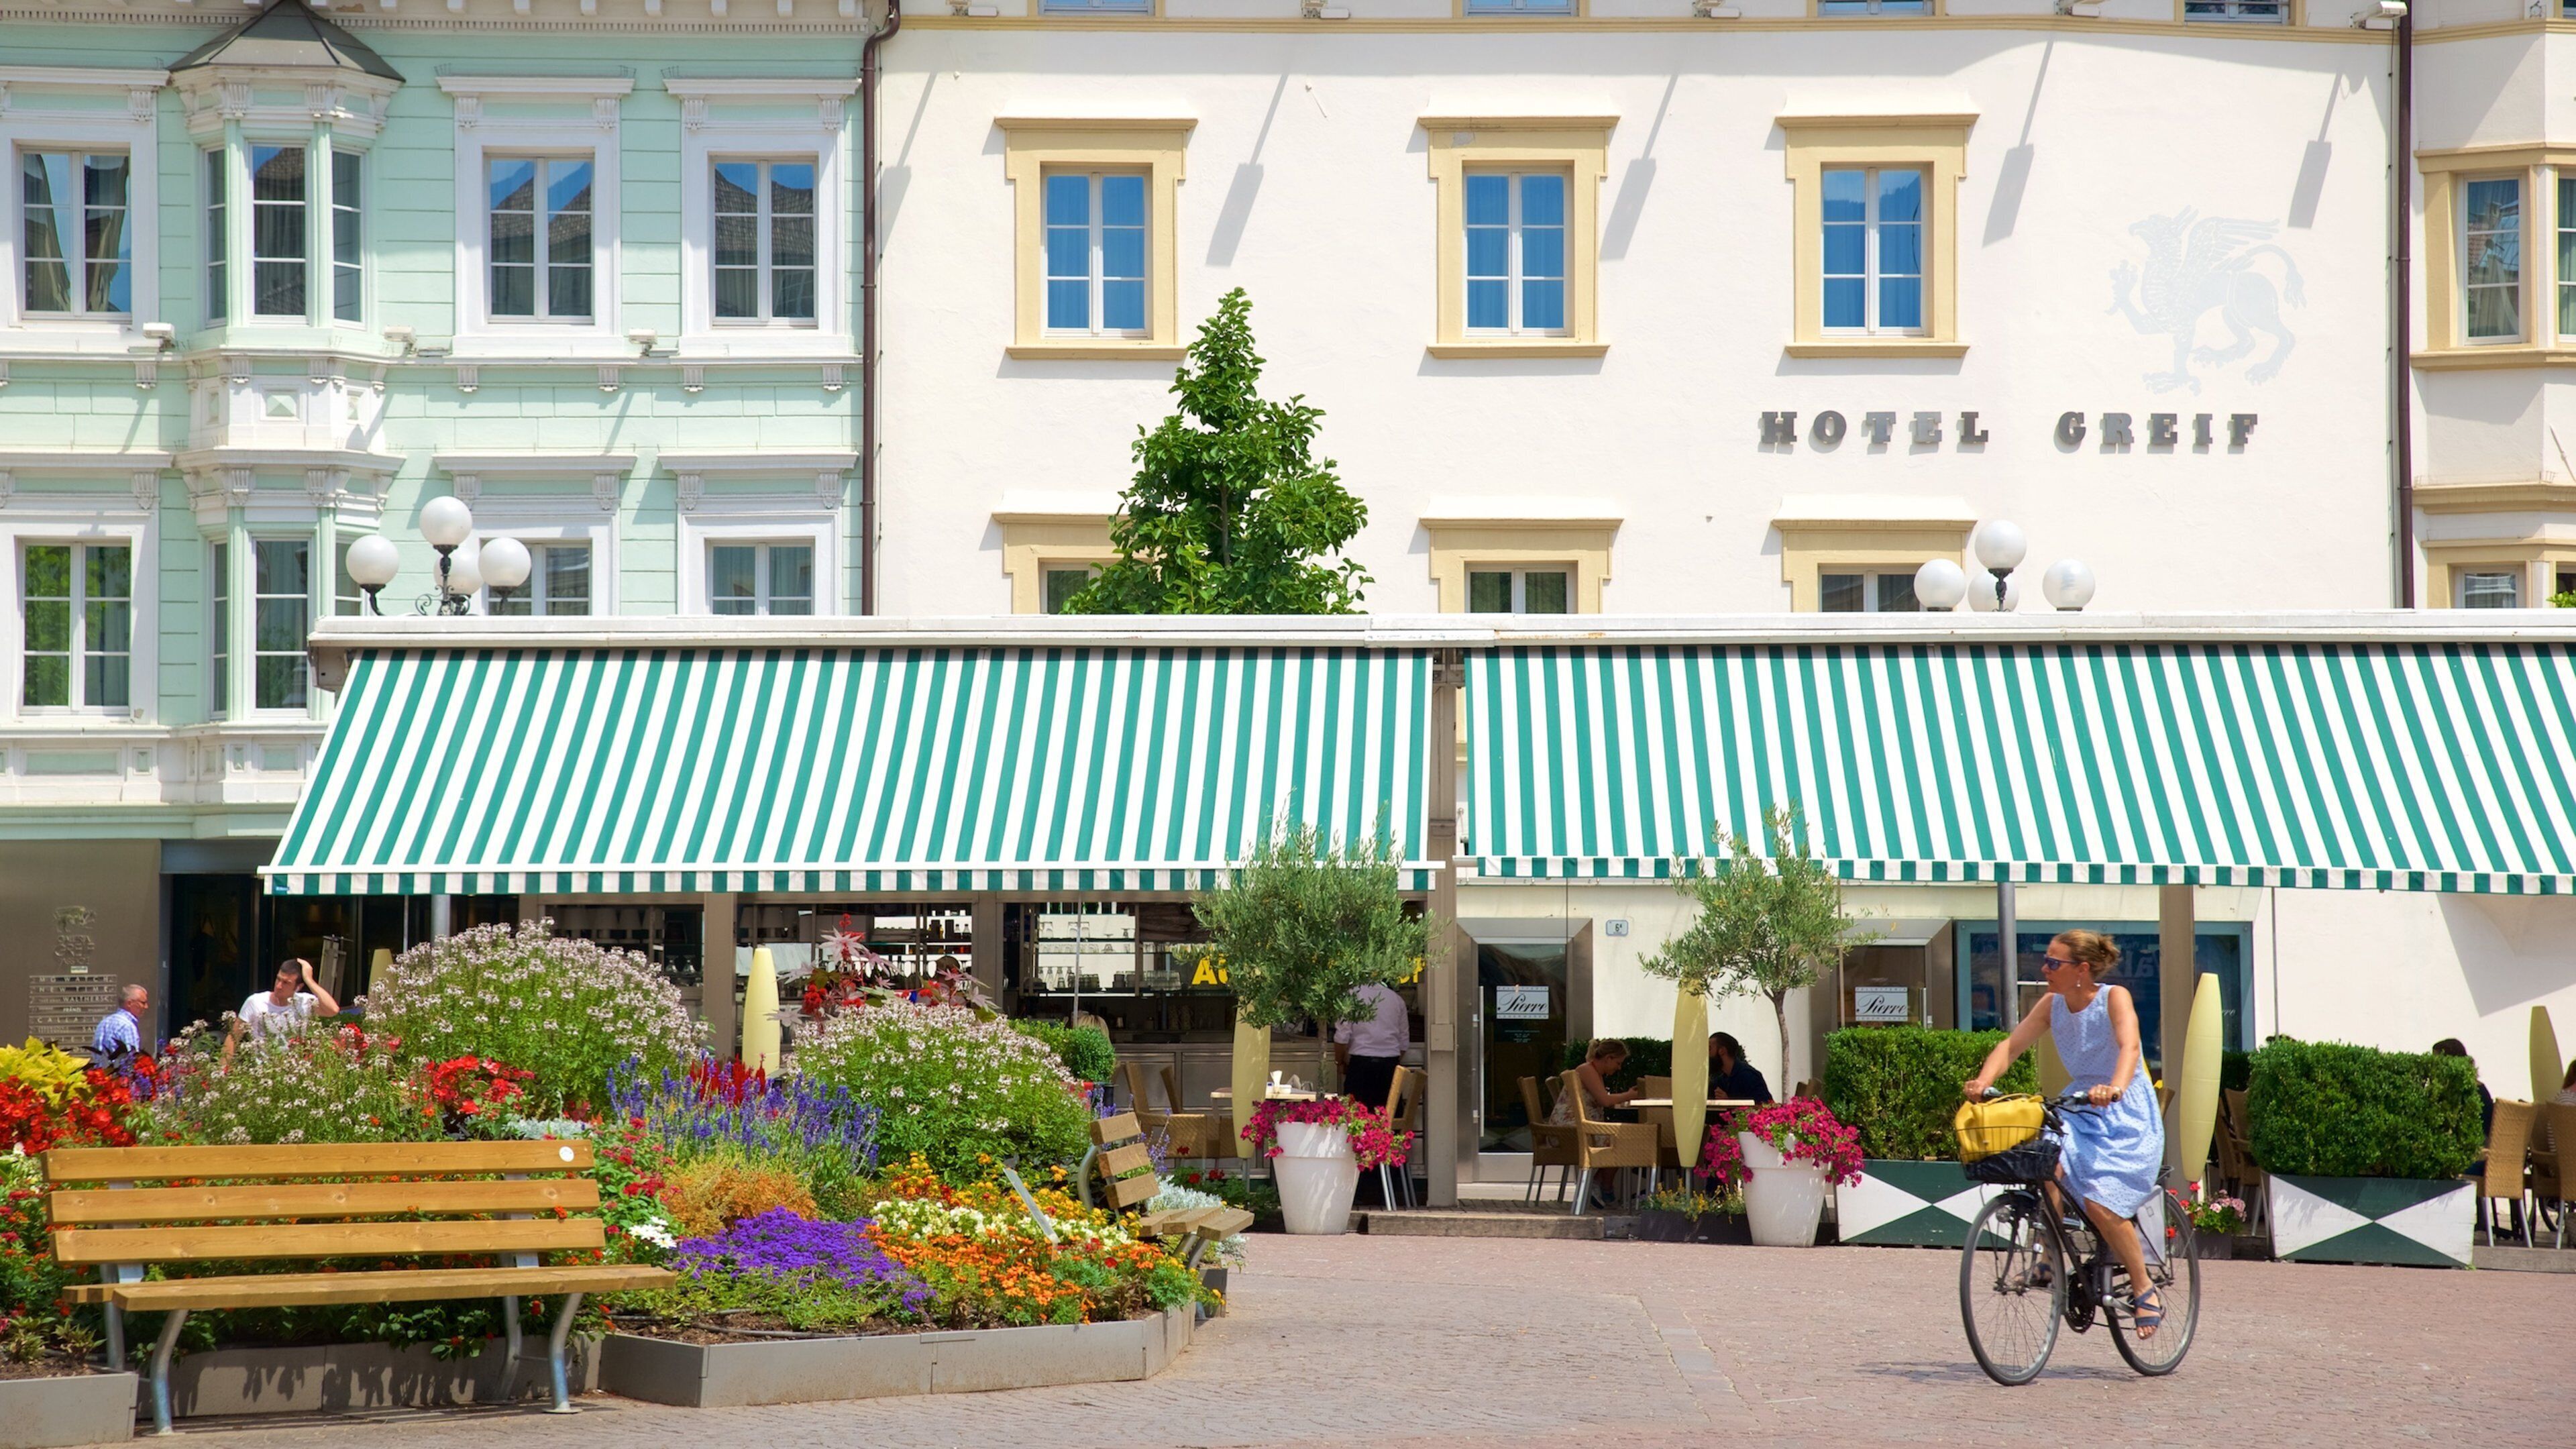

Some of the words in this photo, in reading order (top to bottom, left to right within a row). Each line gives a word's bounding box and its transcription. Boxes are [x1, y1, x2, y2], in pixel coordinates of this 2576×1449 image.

[1761, 409, 1989, 445] HOTEL
[2057, 411, 2258, 445] GREIF
[1497, 992, 1547, 1013] Pierre
[1856, 994, 1907, 1014] Pierre
